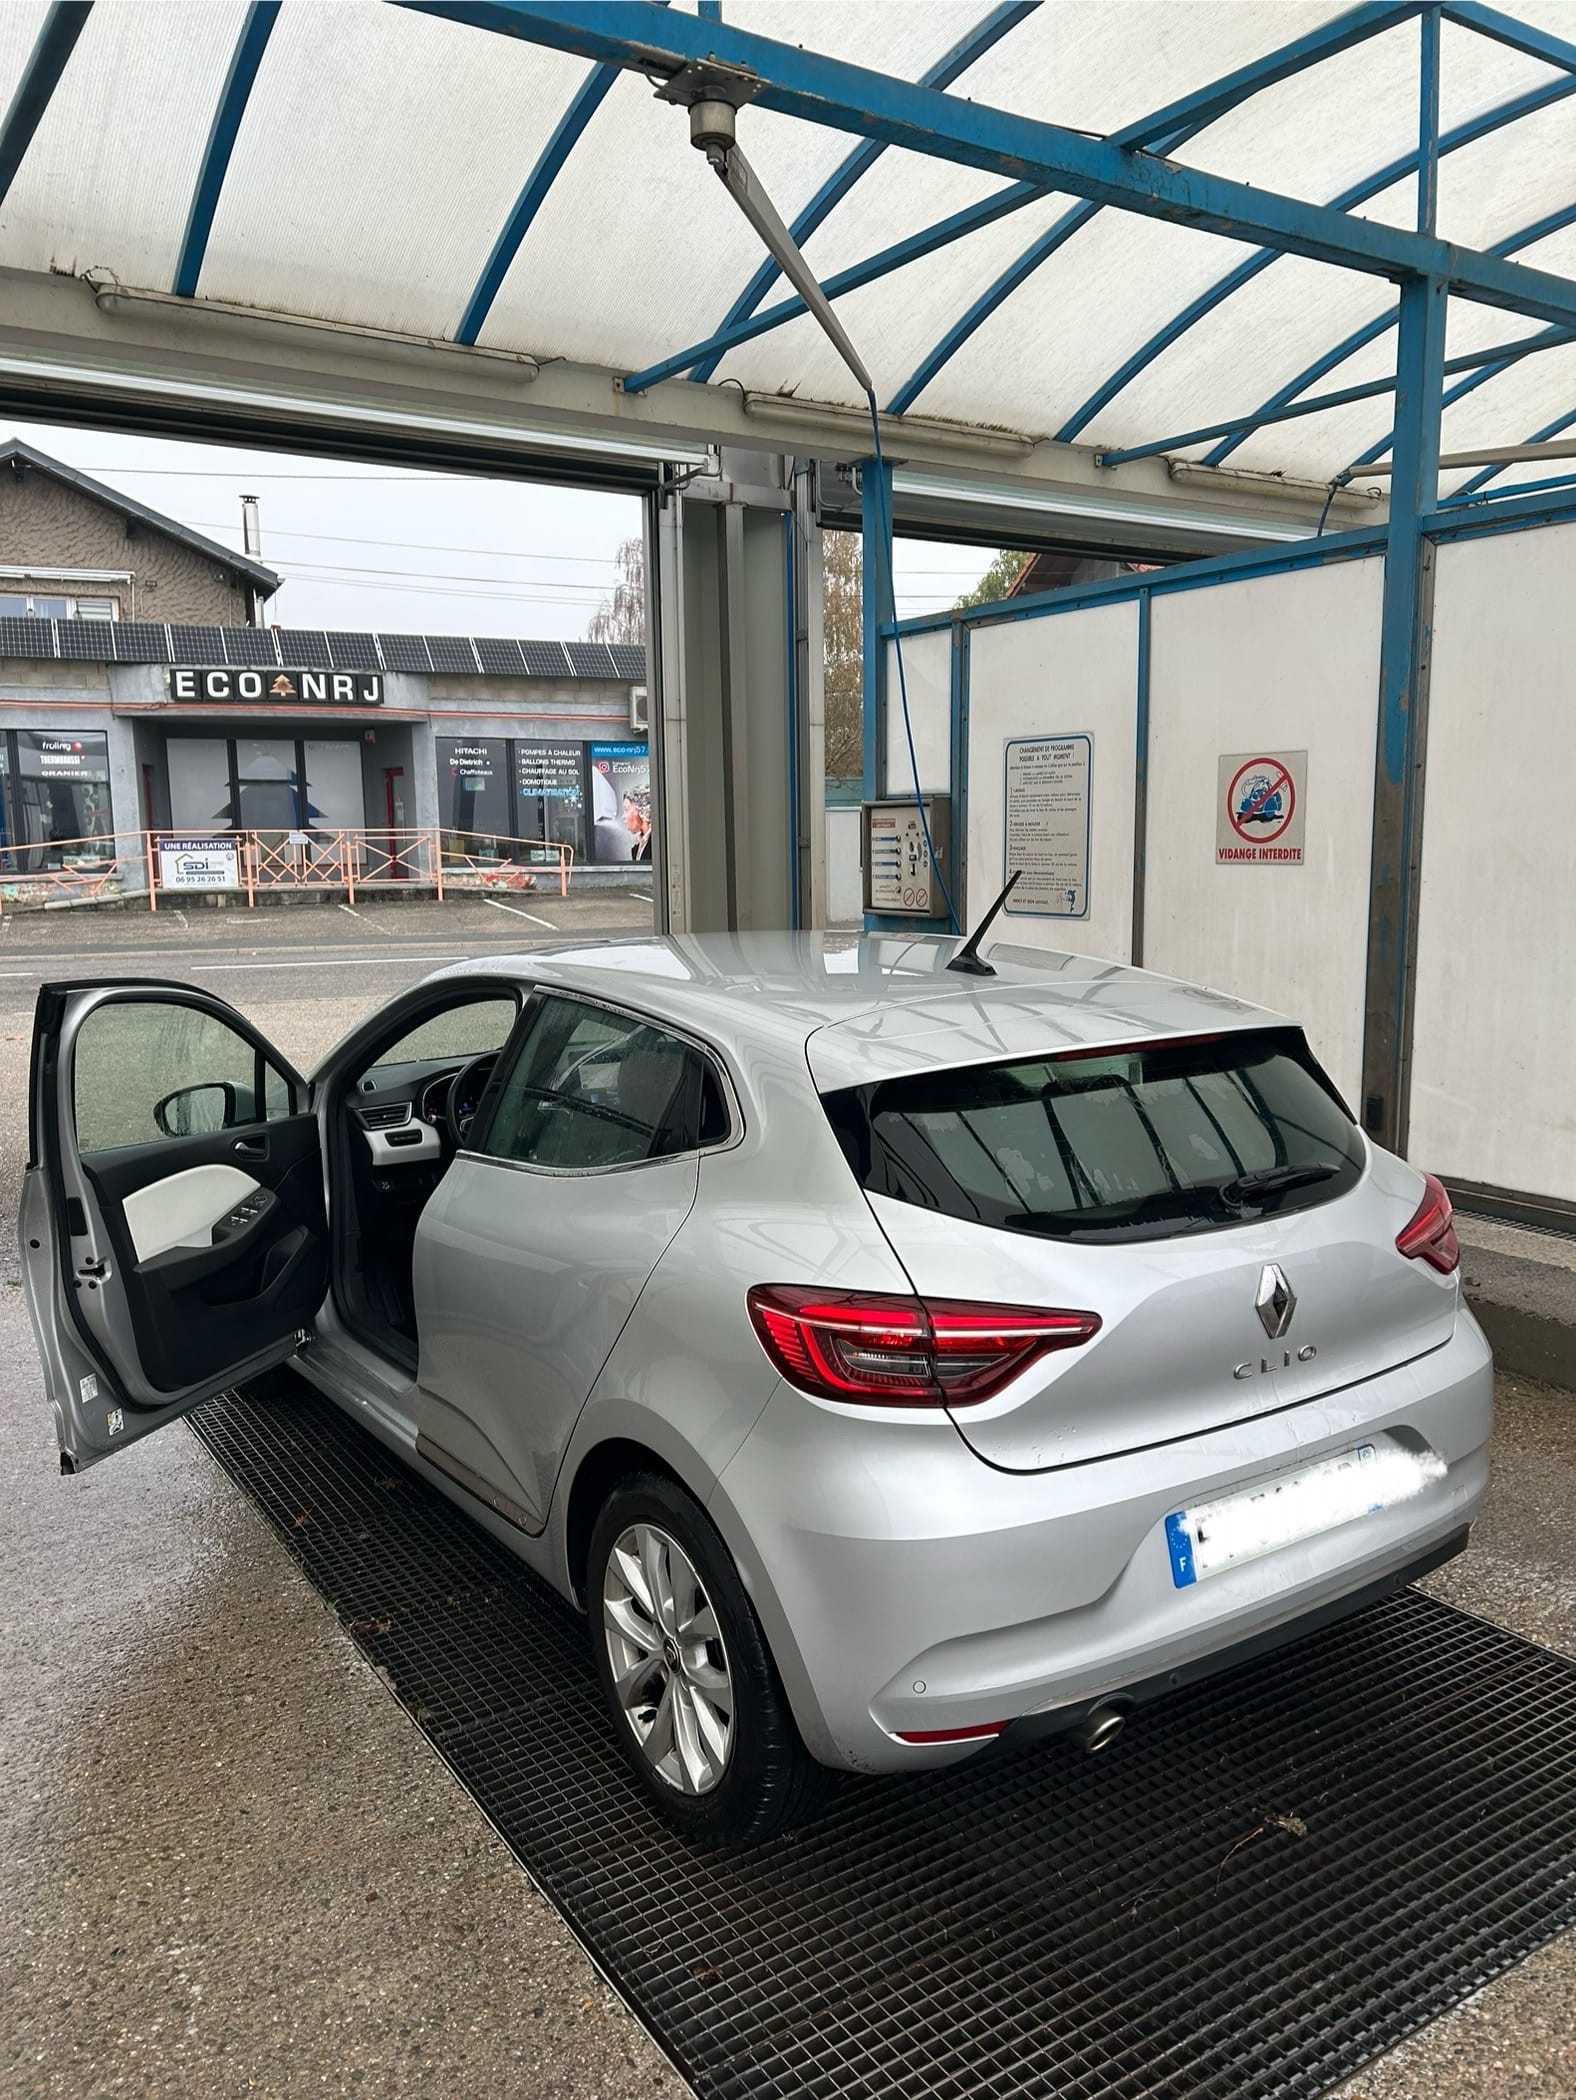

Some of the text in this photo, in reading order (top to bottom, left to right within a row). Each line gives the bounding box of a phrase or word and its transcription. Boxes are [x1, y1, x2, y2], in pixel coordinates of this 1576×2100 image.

[175, 671, 379, 701] ECO NRJ
[454, 747, 488, 755] HITACHI
[553, 749, 581, 757] CHALEUR
[164, 841, 232, 850] UNE RÉALISATION
[1218, 848, 1302, 860] VIDANGE INTERDITE
[186, 875, 196, 883] 95
[196, 875, 206, 883] 26
[1233, 1344, 1317, 1380] CLIO
[1179, 1556, 1187, 1572] F
